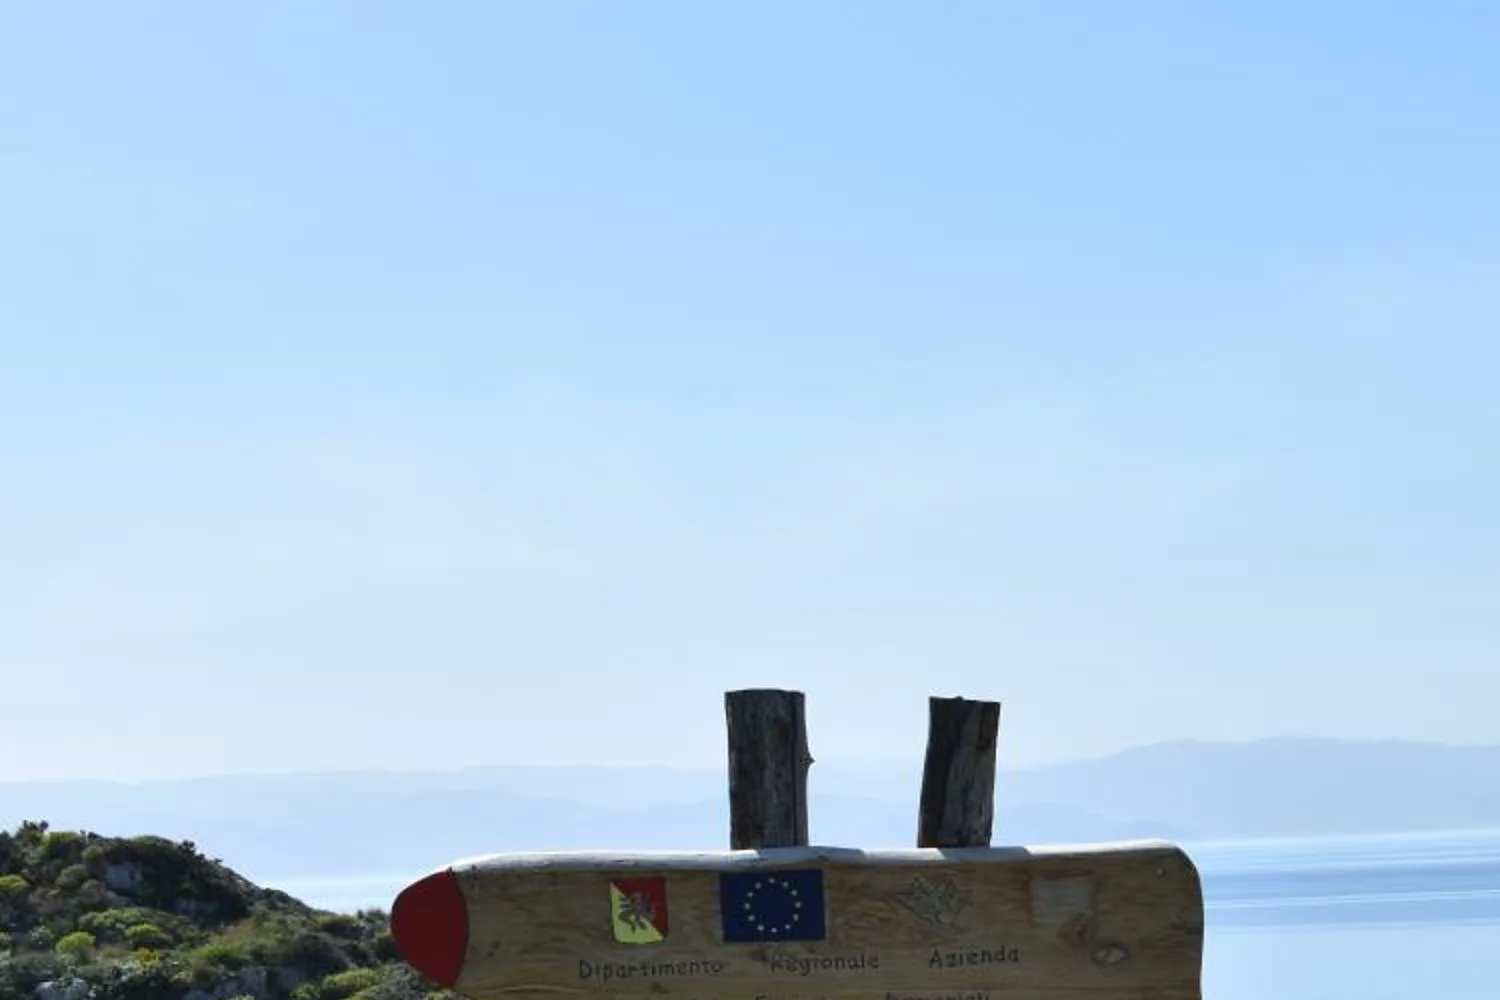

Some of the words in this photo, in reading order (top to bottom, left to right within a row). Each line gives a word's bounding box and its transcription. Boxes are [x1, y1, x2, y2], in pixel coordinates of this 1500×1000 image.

[579, 958, 725, 983] Dipartimento
[771, 950, 880, 976] Regionale
[928, 944, 1020, 968] Azienda
